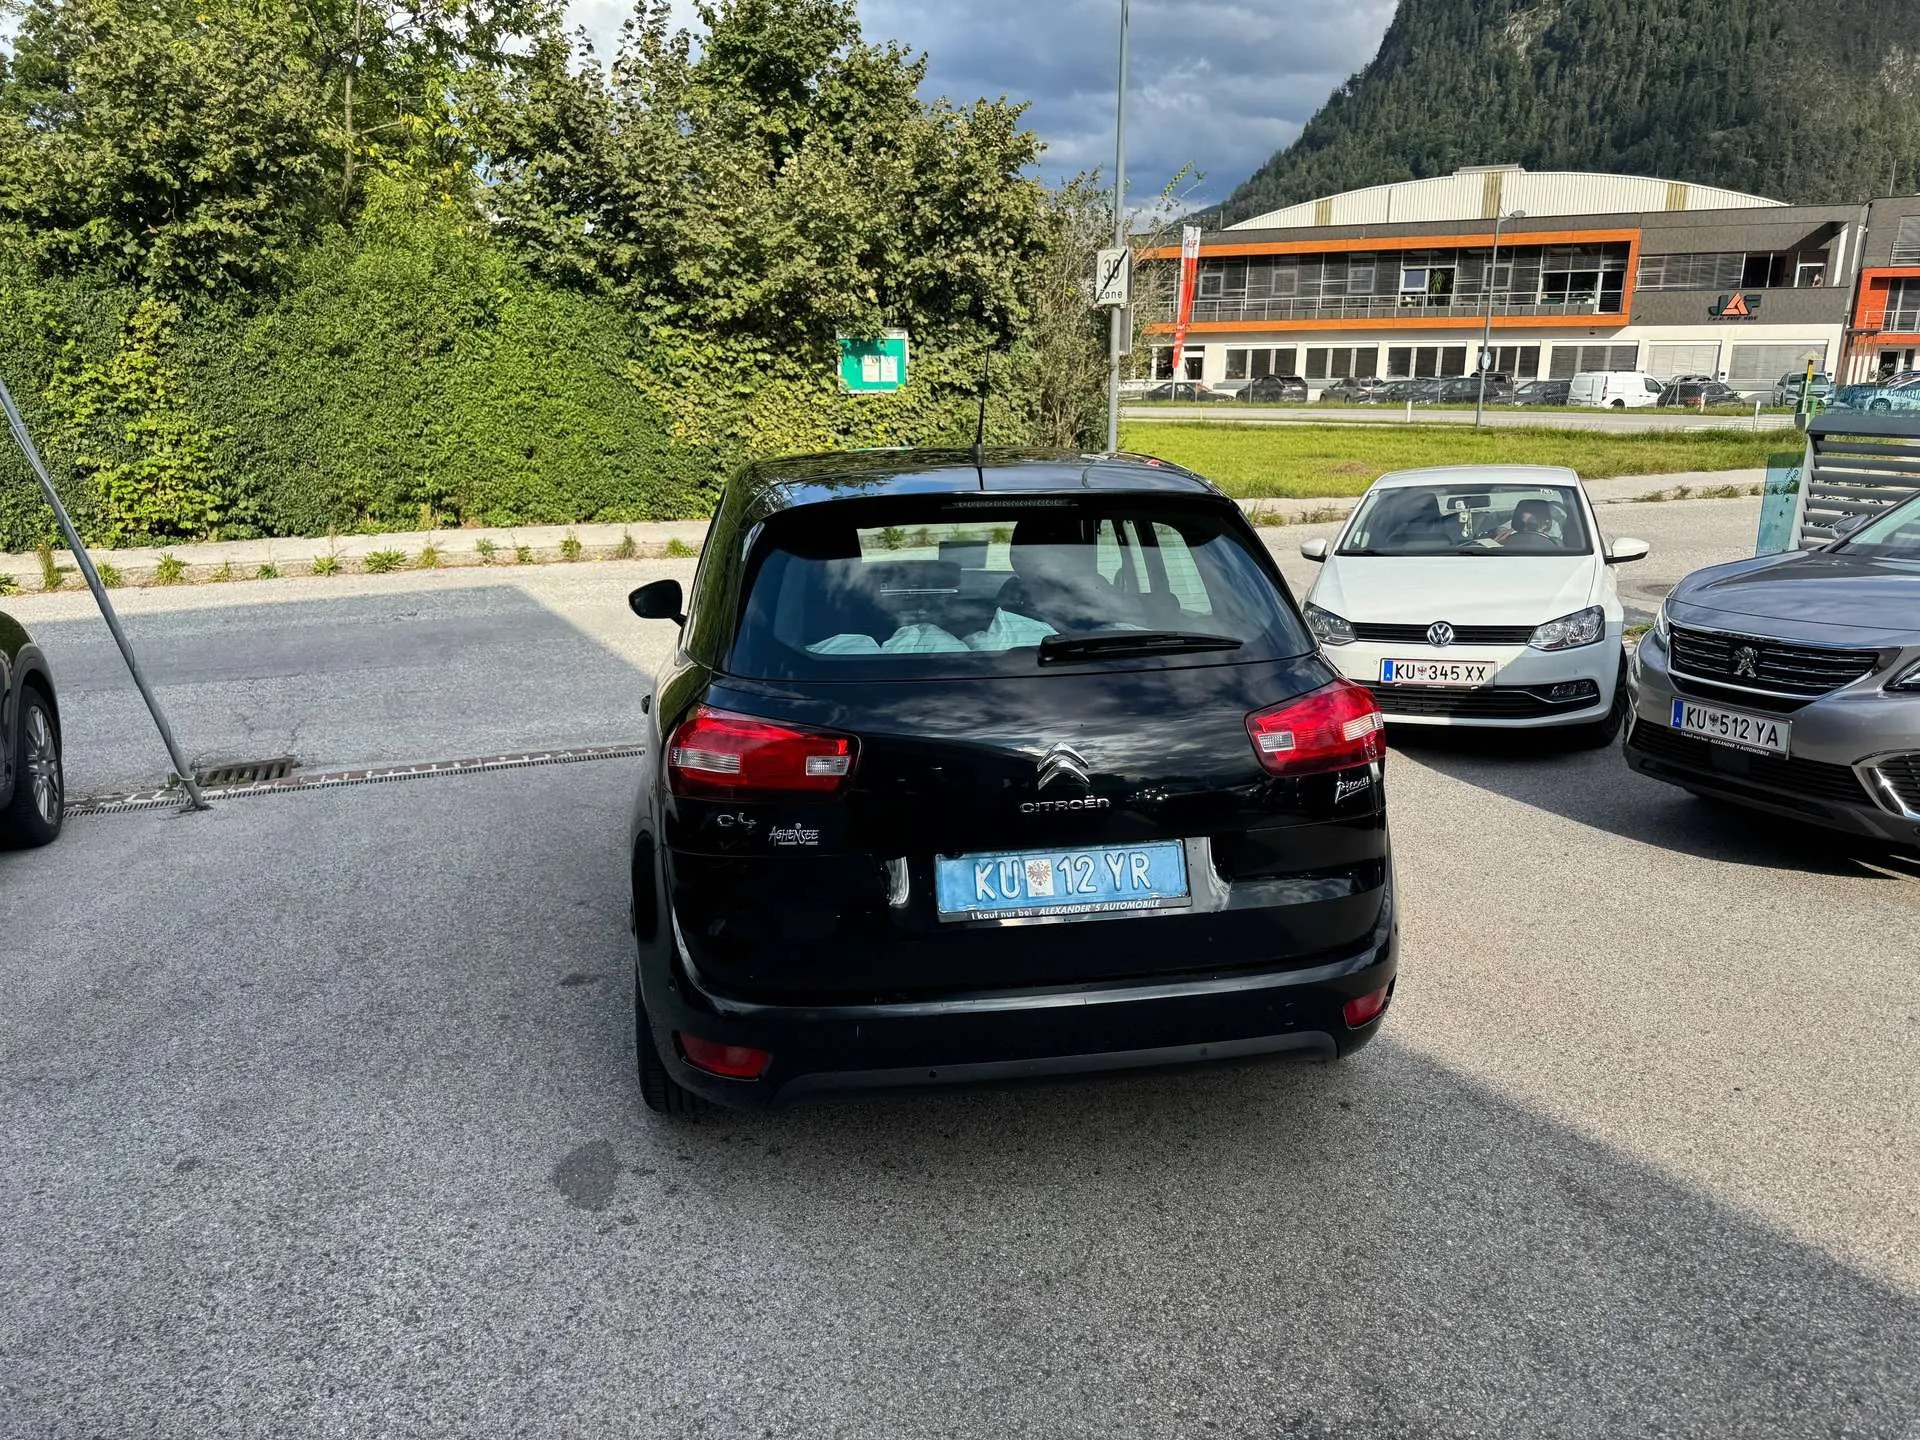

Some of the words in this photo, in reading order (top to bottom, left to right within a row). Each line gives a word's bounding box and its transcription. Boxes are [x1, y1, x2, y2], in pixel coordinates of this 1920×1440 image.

[1103, 258, 1120, 280] 30
[1100, 289, 1123, 300] Zone
[1395, 663, 1416, 680] KU
[1428, 665, 1461, 681] 345
[1465, 666, 1486, 681] XX
[1686, 706, 1707, 730] KU
[1720, 714, 1750, 740] 512
[1756, 721, 1778, 747] YA
[1020, 794, 1111, 813] CITROËN
[973, 858, 1022, 901] KU
[1057, 855, 1098, 895] 12
[1104, 850, 1152, 891] YR
[977, 911, 999, 920] kauf
[1018, 908, 1033, 917] bei
[1102, 899, 1161, 912] AUTOMOBILE
